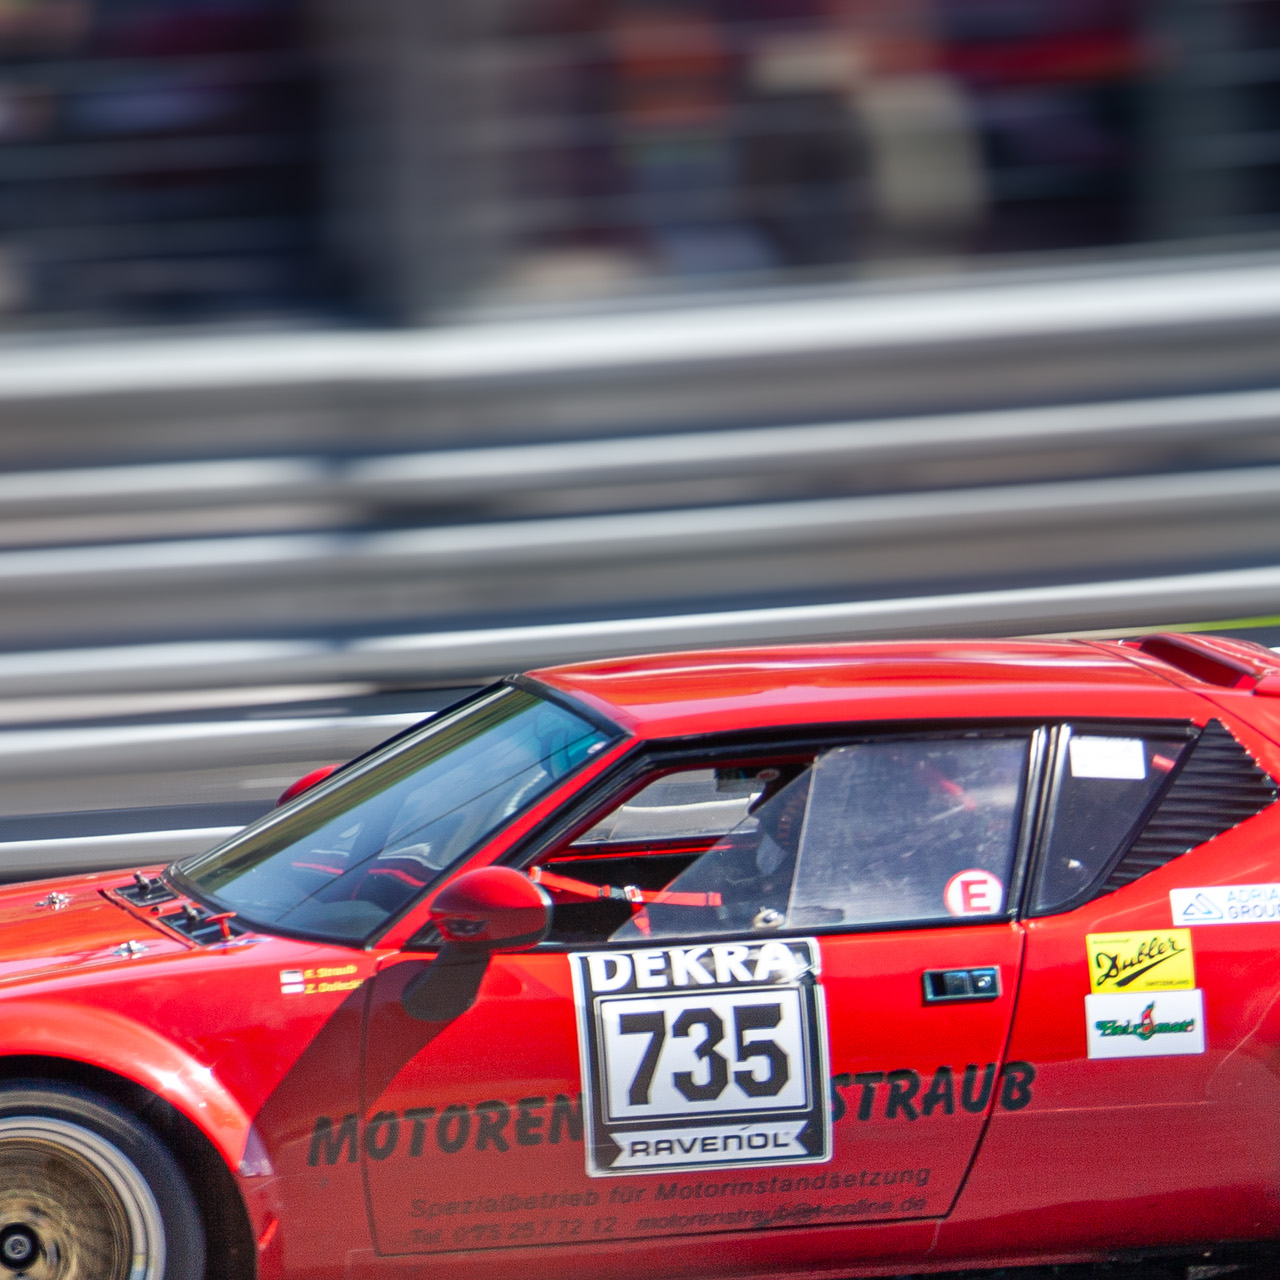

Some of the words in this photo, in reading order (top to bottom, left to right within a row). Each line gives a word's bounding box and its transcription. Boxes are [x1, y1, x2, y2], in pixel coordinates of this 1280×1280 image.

[961, 878, 991, 914] E
[587, 942, 801, 992] DEKRA
[619, 1003, 790, 1106] 735
[307, 1092, 584, 1167] MOTOREN
[831, 1060, 1037, 1123] STRAUB
[629, 1131, 790, 1158] RAVENOL
[608, 1184, 647, 1205] für
